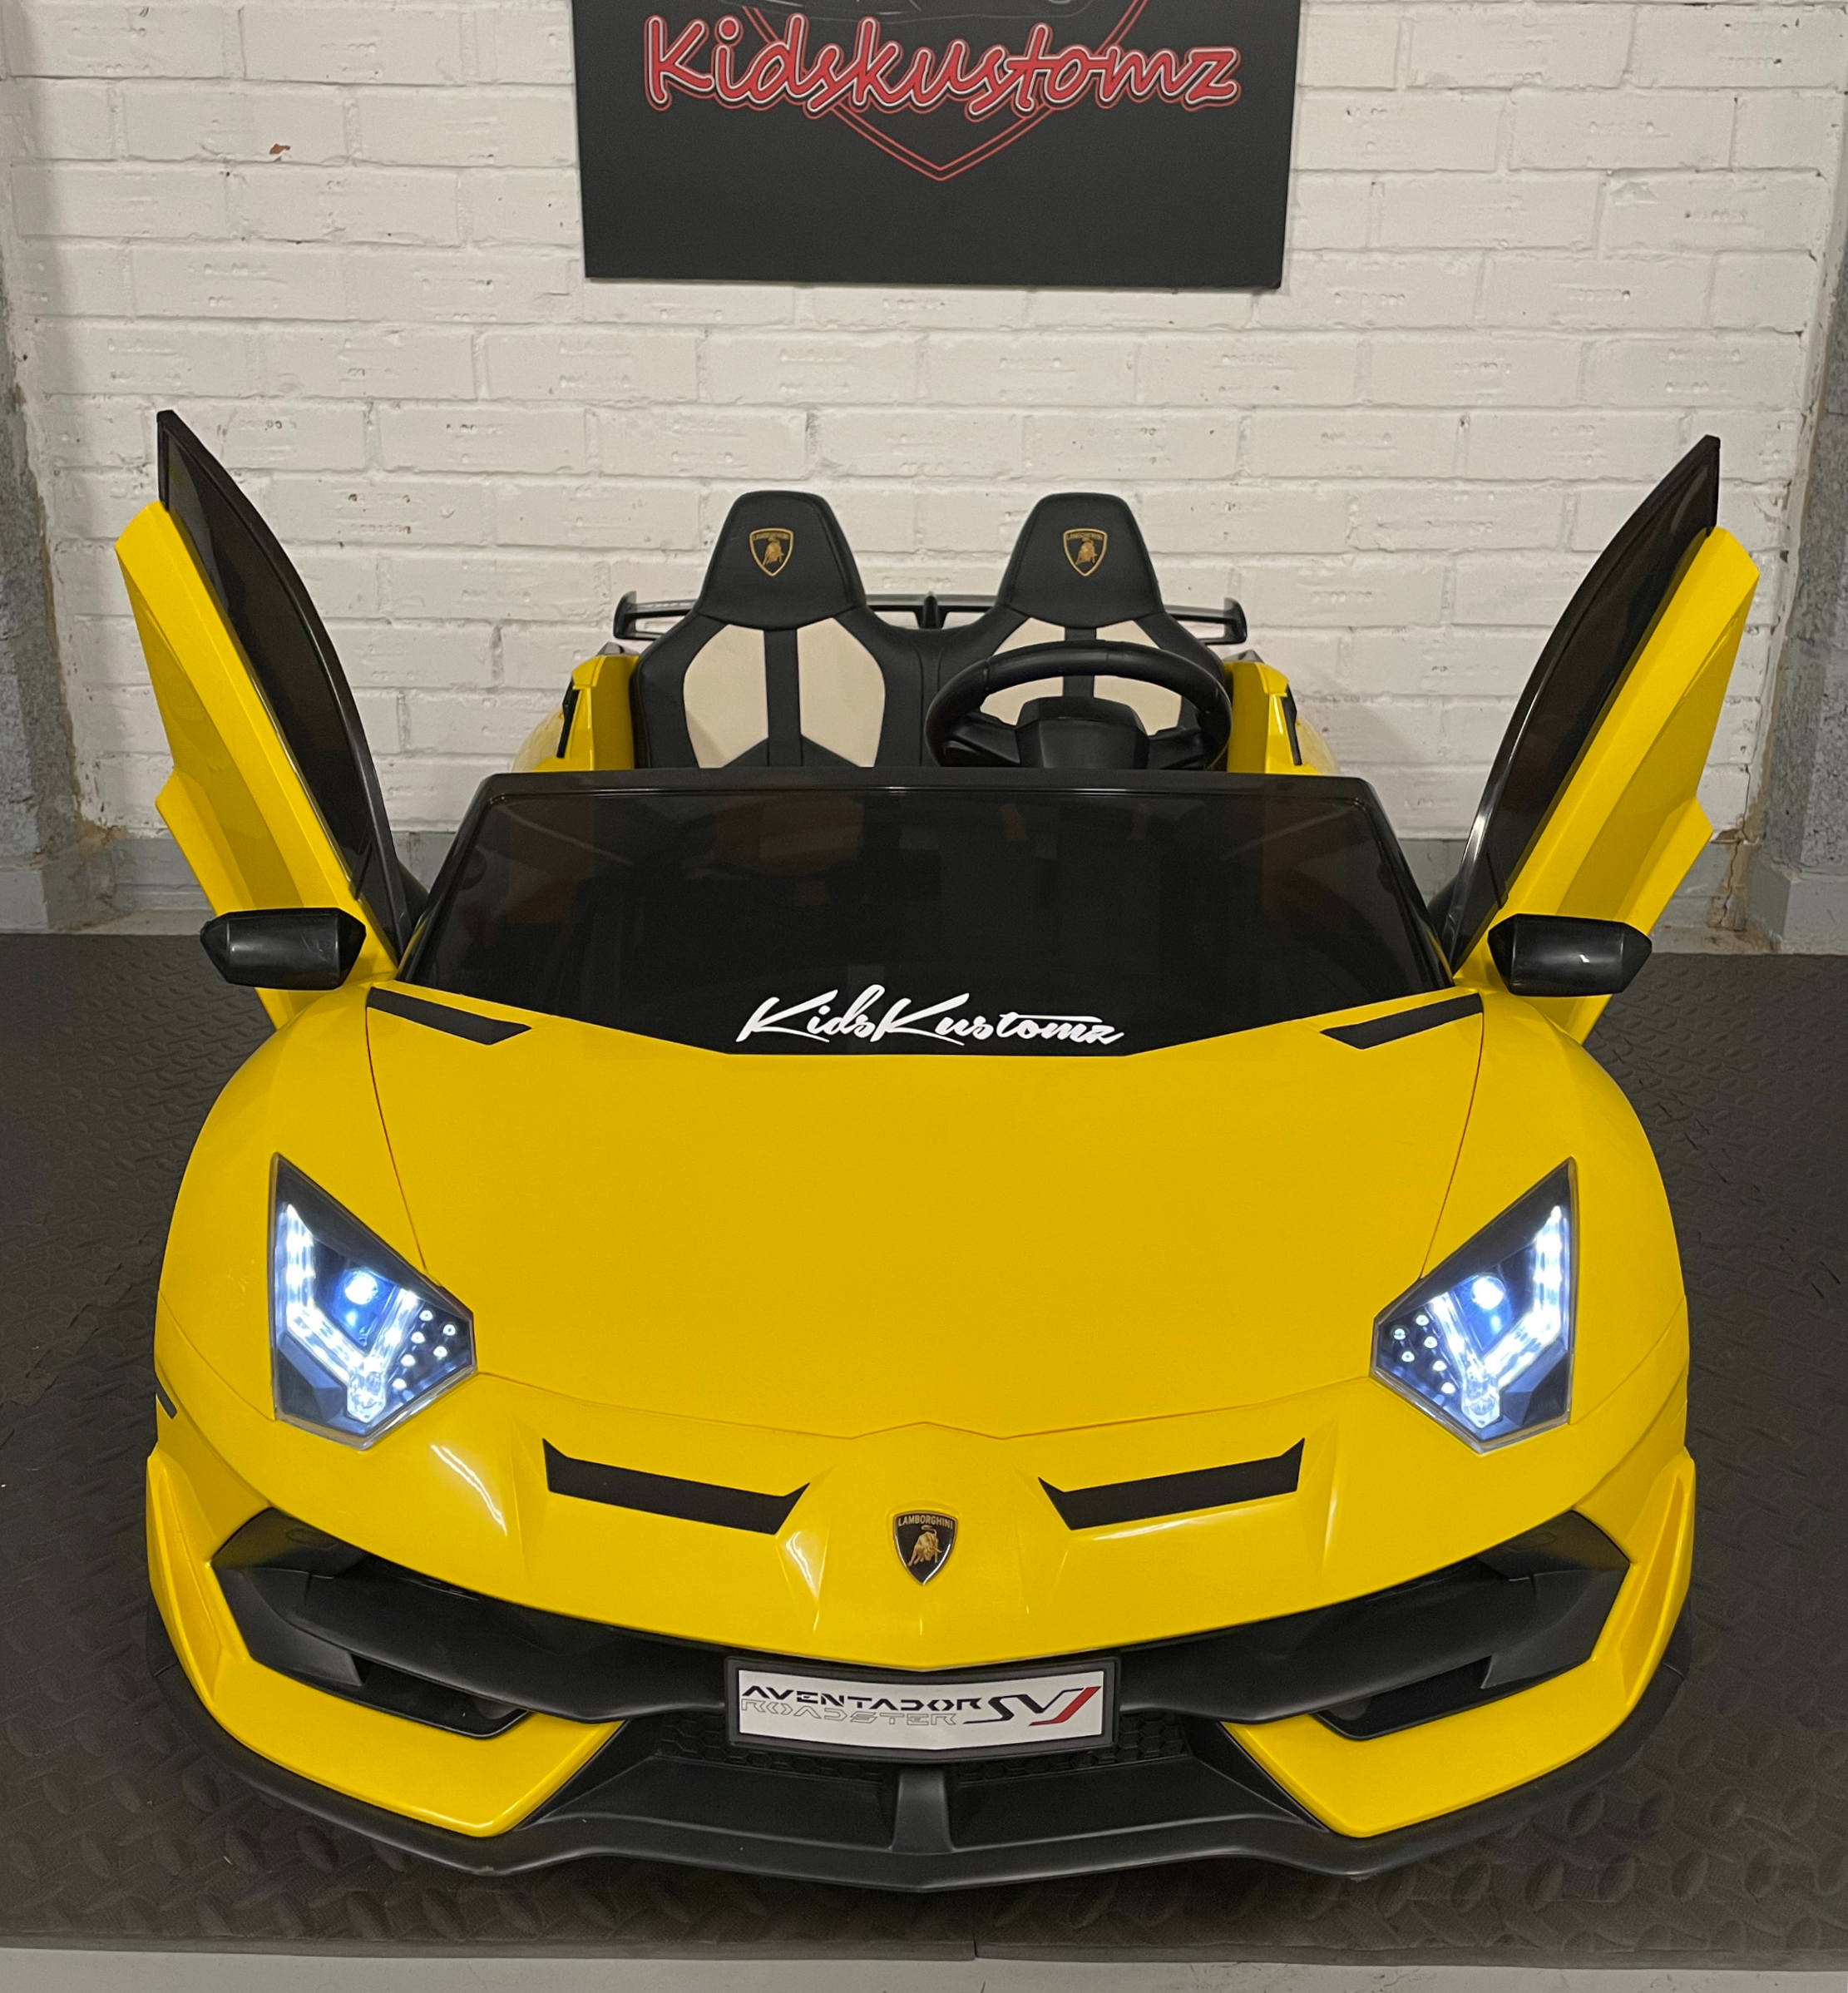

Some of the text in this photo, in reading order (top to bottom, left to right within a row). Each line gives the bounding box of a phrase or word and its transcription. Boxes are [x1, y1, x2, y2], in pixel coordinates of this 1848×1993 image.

[644, 14, 1241, 121] Kidskustomz
[898, 1515, 953, 1530] LAMBORGHINI
[741, 1685, 982, 1711] AVENTADOR
[741, 1698, 956, 1726] ROADSTER
